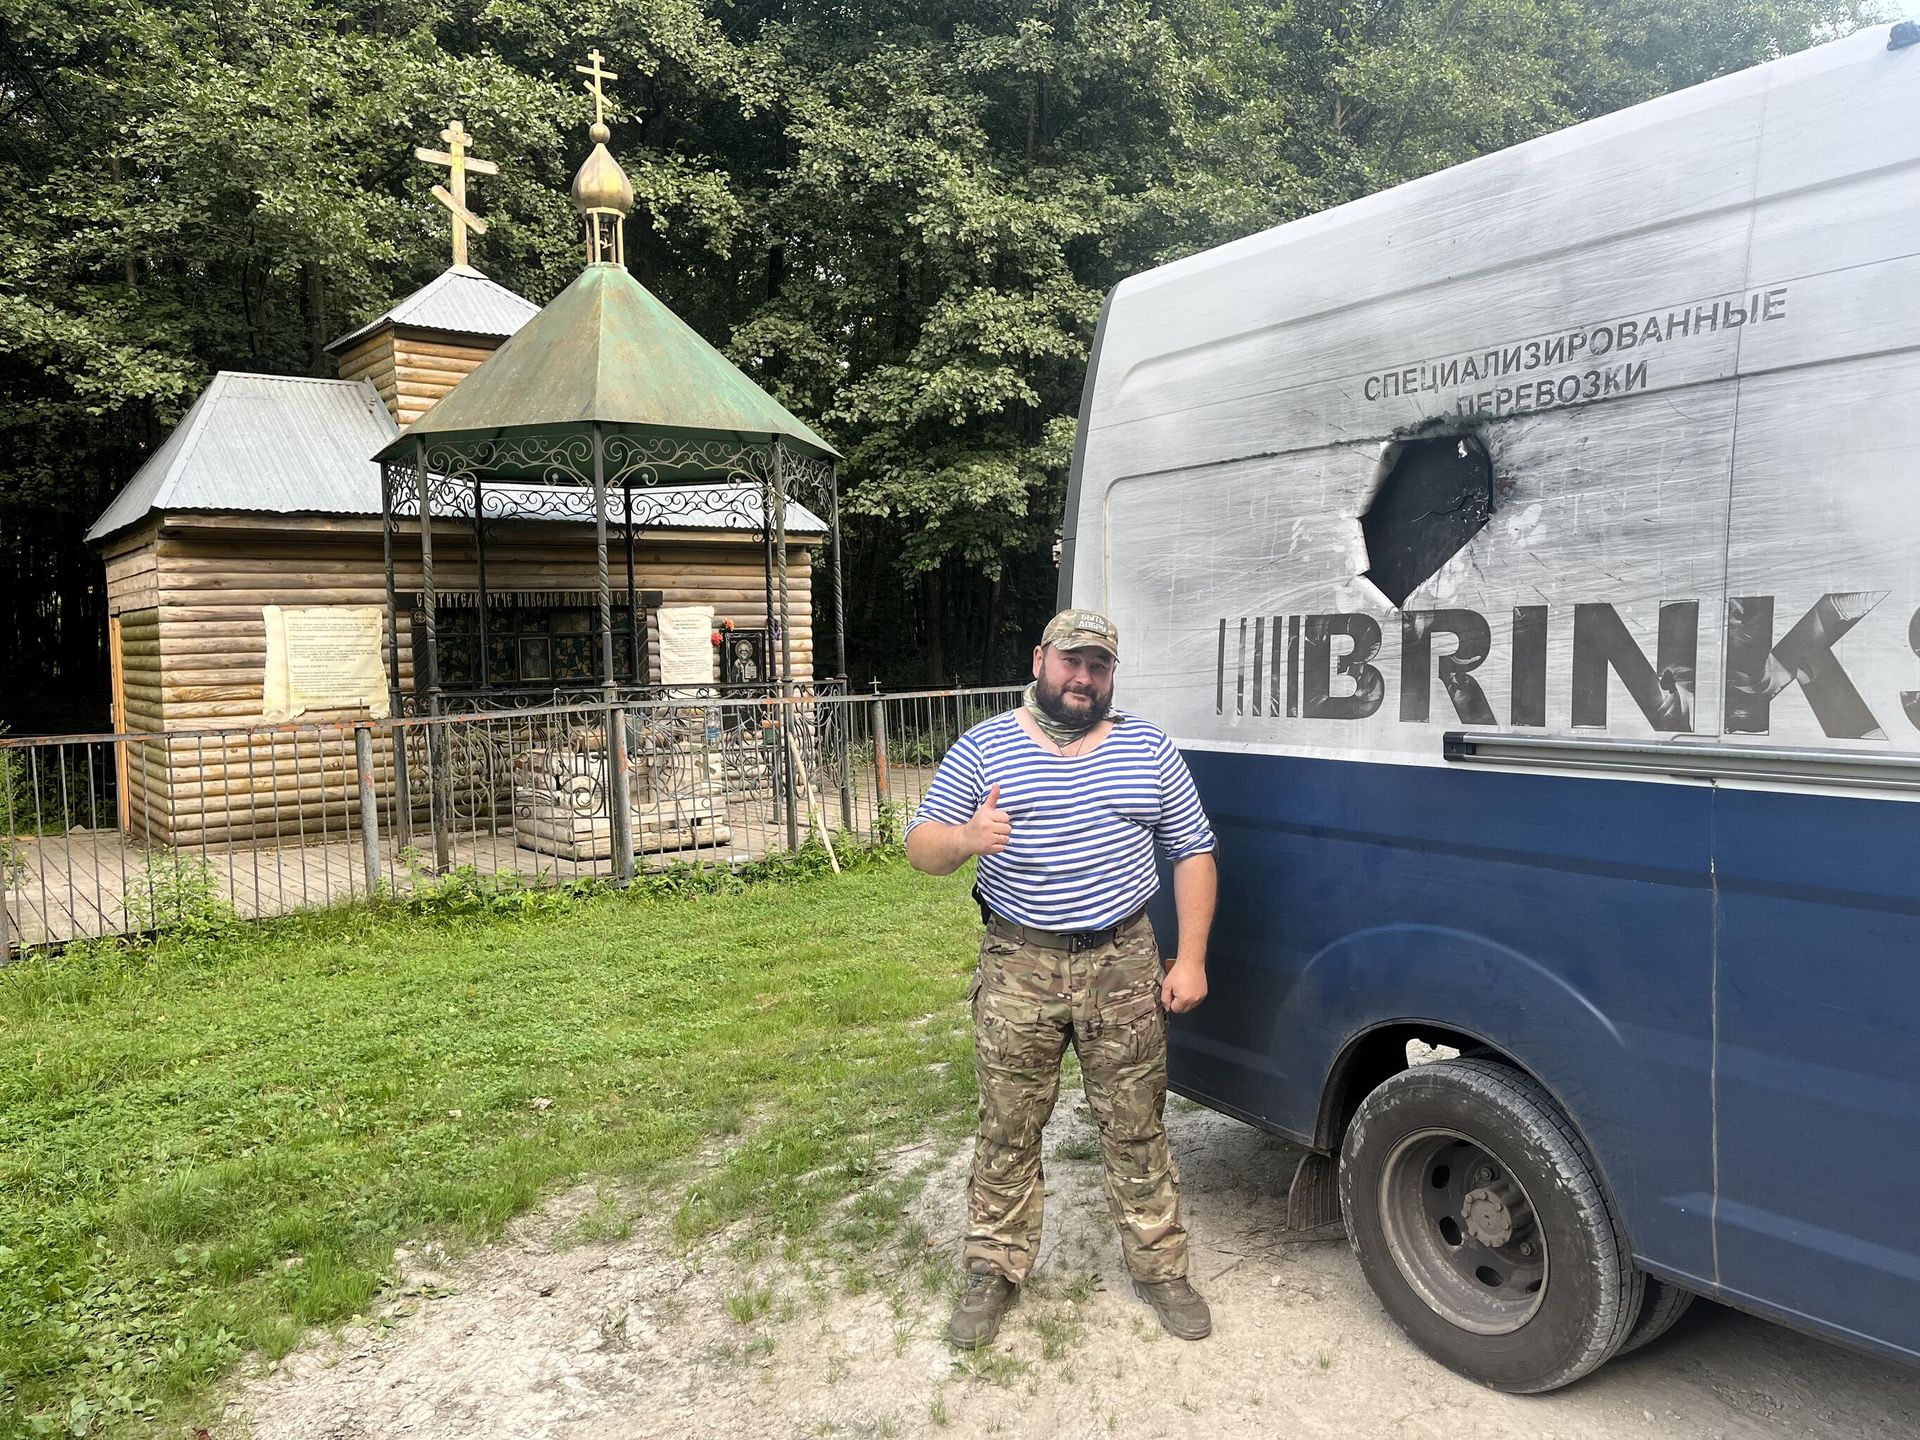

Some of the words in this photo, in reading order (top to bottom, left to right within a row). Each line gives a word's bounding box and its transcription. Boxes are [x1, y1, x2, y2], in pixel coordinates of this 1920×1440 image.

[1364, 288, 1788, 402] СПЕЦИАЛИЗИРОВАННЫЕ
[1456, 360, 1648, 417] ПЕРЕВОЗКИ
[486, 592, 513, 608] ОТЧЕ
[1081, 613, 1104, 625] БЫТЬ
[1303, 590, 1920, 741] BRINK
